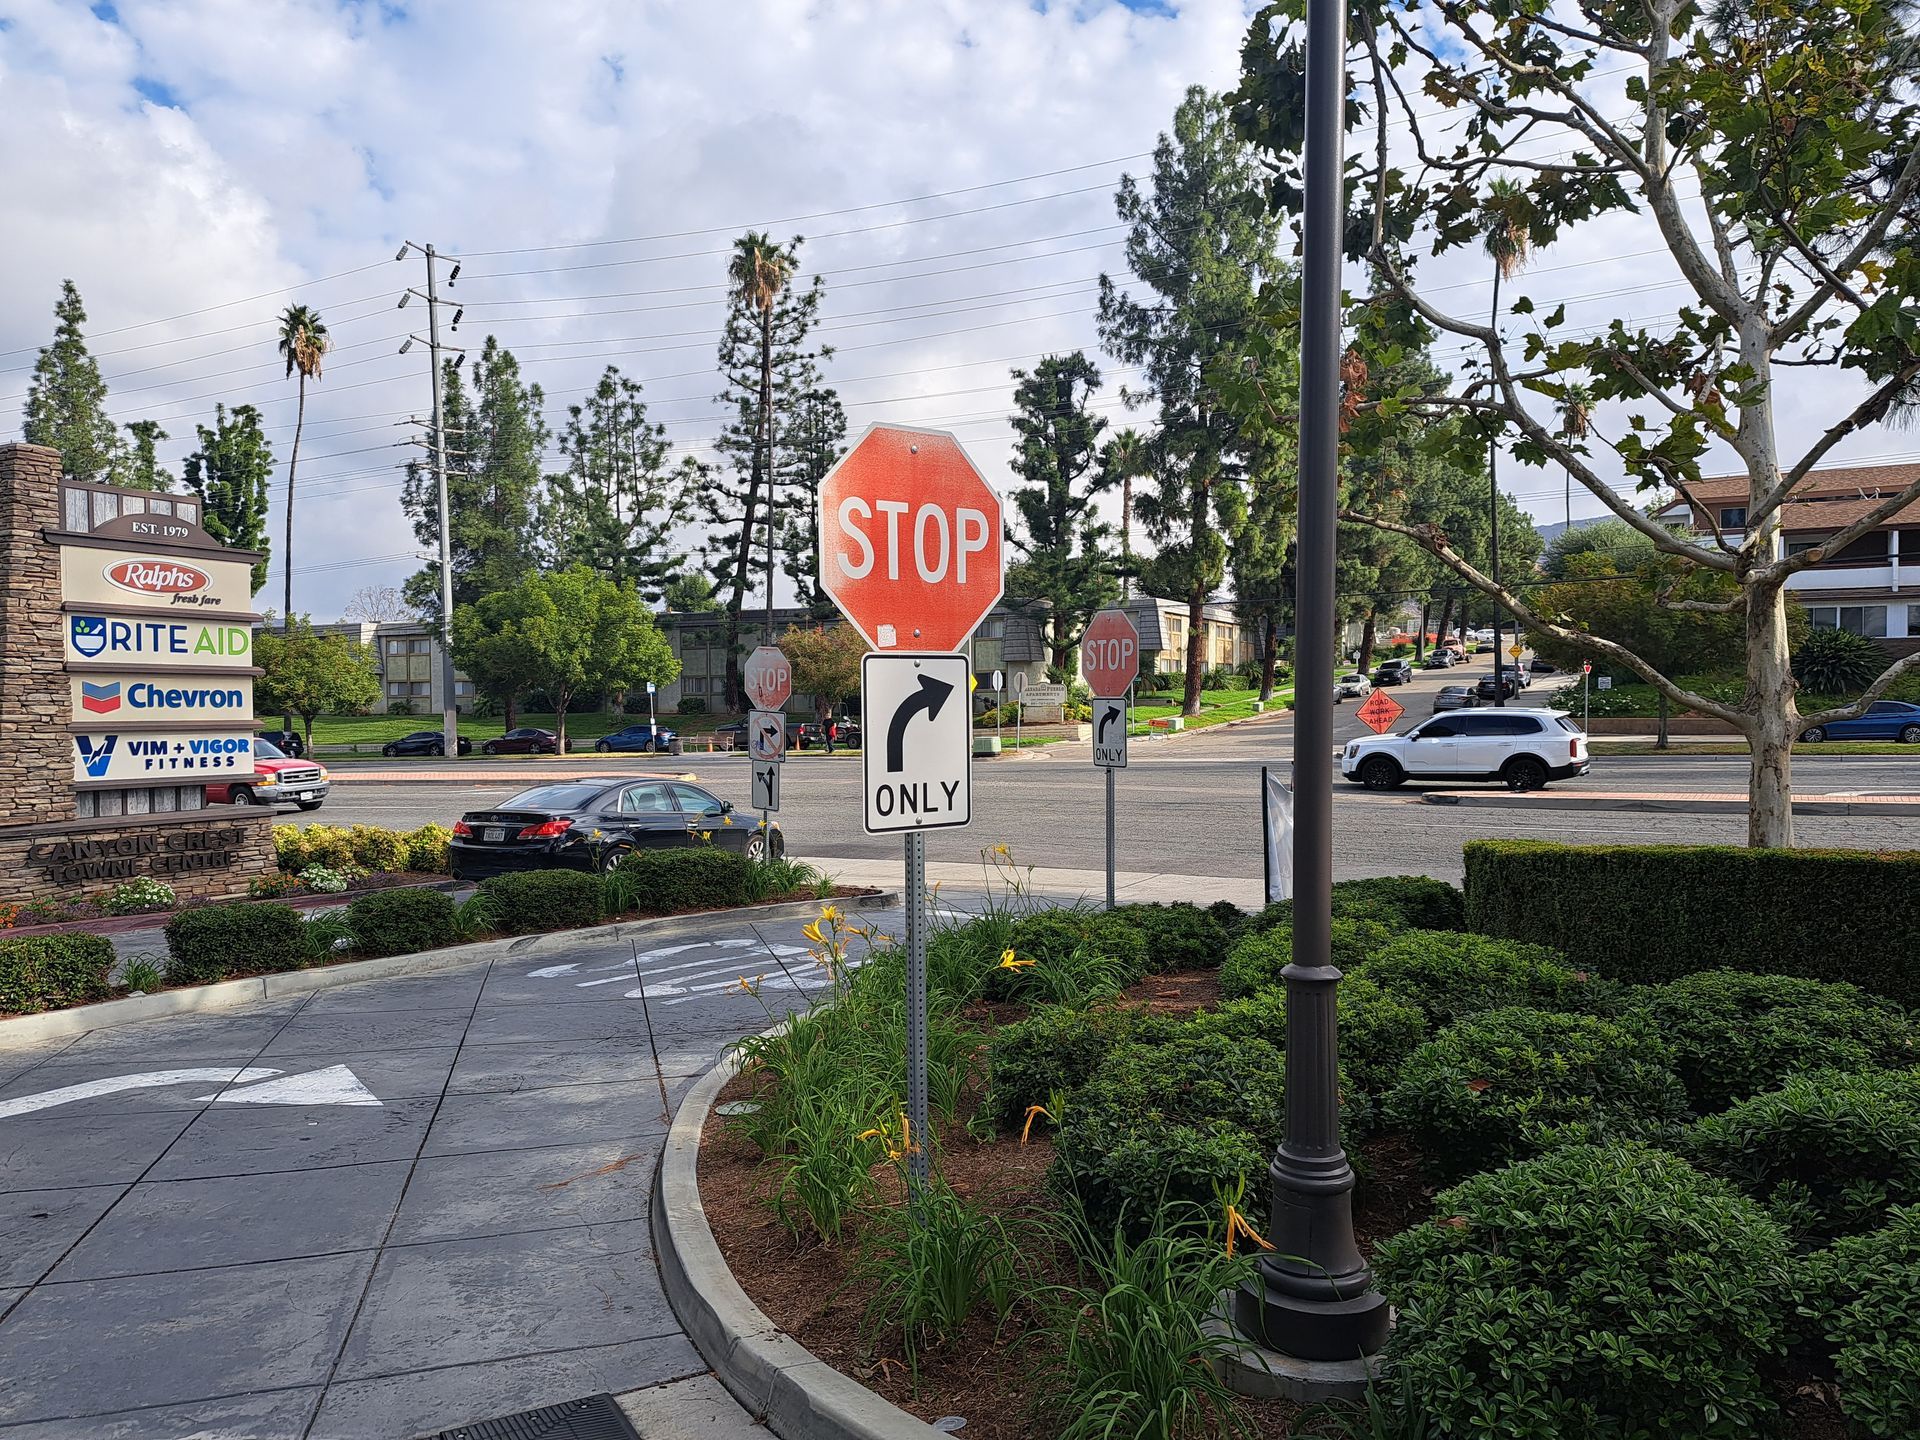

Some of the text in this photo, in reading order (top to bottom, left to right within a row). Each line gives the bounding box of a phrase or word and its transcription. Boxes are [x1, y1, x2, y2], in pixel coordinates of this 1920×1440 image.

[132, 521, 189, 538] EST. 1979
[836, 496, 989, 584] STOP
[123, 563, 195, 591] Ralphs
[198, 595, 221, 607] fare
[111, 621, 249, 656] RITE AID
[1086, 638, 1134, 671] STOP
[748, 667, 787, 692] STOP
[127, 683, 243, 709] Chevron
[1370, 699, 1389, 707] ROAD
[1369, 717, 1393, 725] AHEAD
[128, 741, 167, 756] VIM
[189, 738, 249, 755] VIGOR
[1095, 748, 1123, 762] ONLY
[145, 756, 235, 770] FITNESS
[876, 780, 960, 817] ONLY
[29, 828, 249, 867] CANYON CREST
